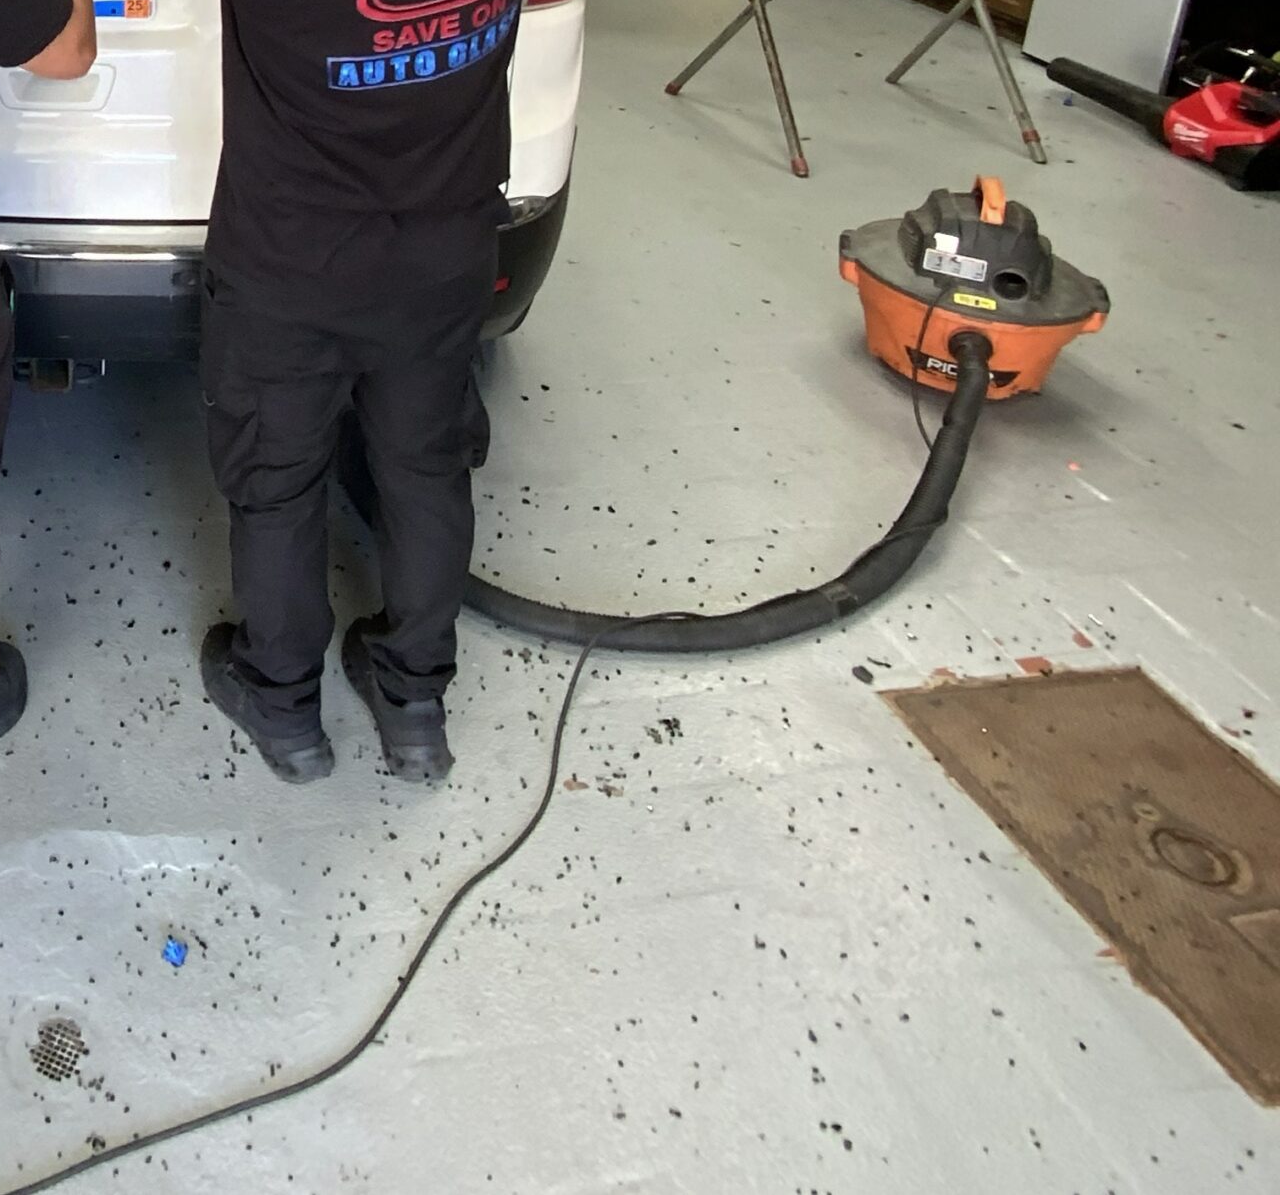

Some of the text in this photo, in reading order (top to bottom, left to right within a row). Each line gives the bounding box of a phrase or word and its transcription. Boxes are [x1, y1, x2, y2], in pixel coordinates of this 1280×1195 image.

[127, 0, 144, 11] 25
[373, 12, 460, 53] SAVE
[337, 50, 436, 87] AUTO
